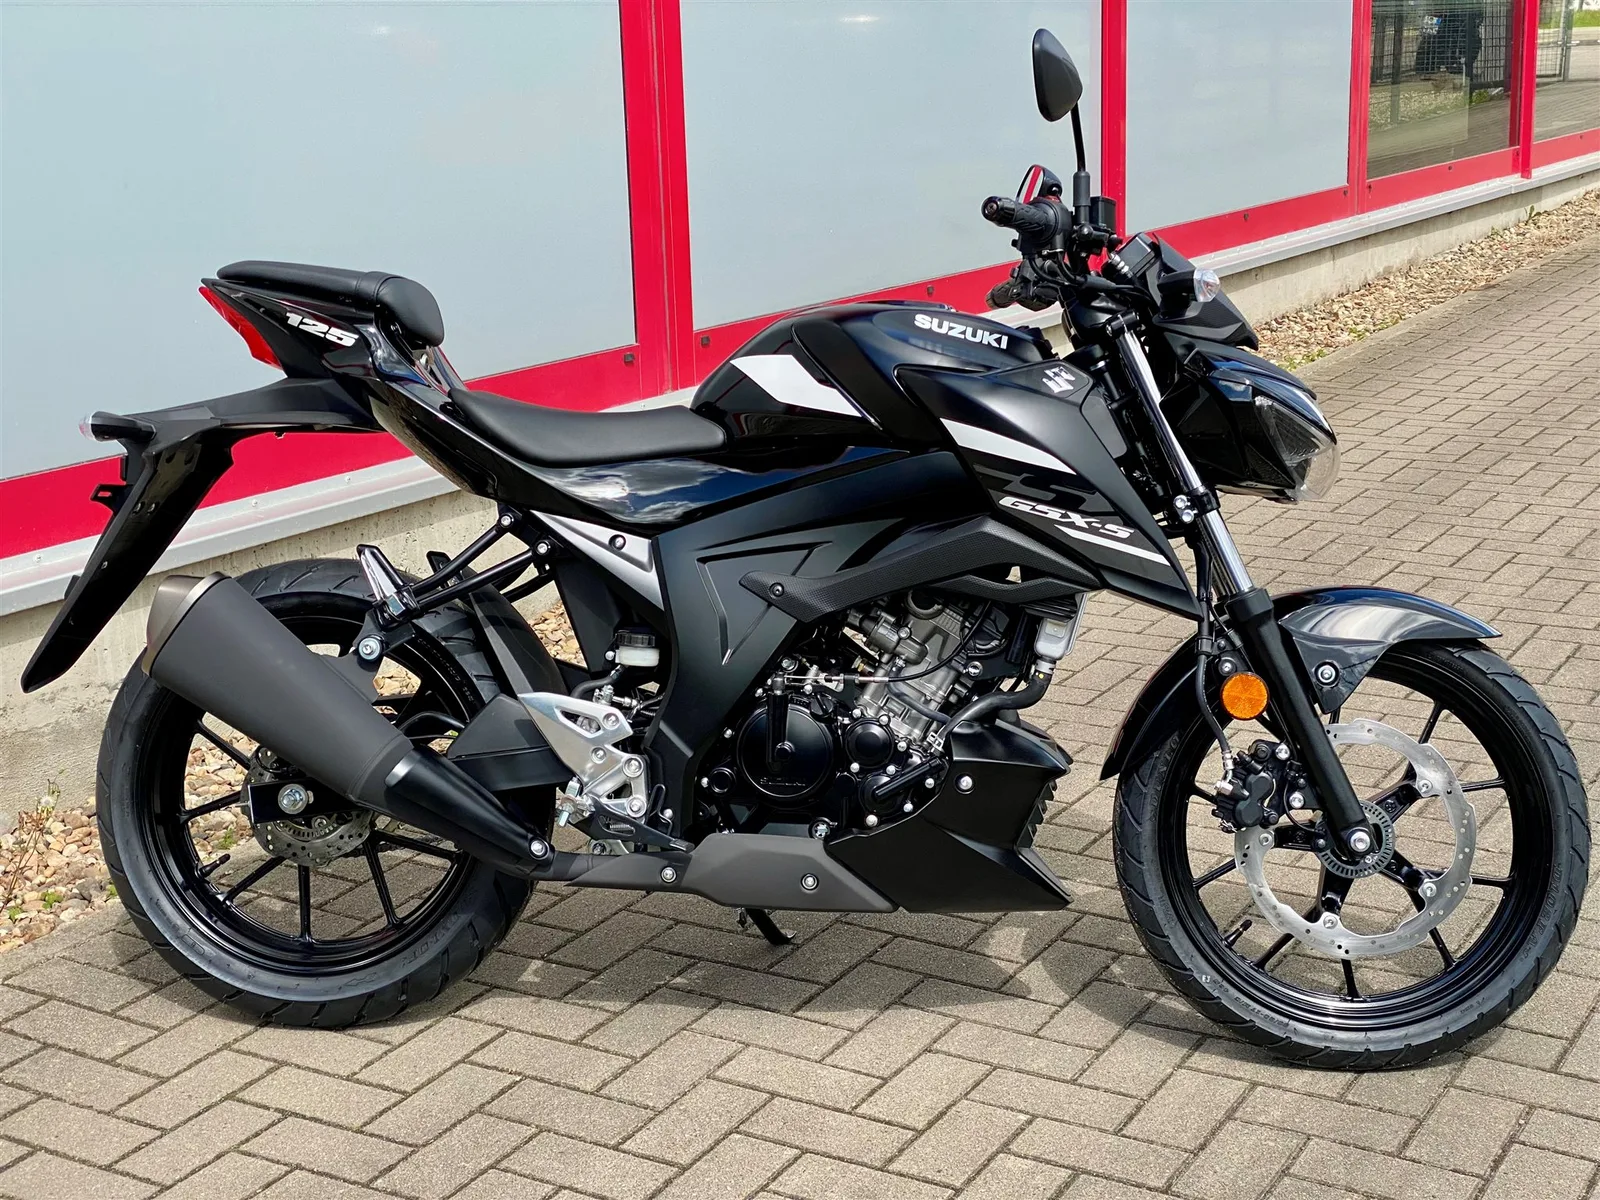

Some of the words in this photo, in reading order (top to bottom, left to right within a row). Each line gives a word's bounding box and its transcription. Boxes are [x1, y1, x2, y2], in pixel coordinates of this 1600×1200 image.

[285, 312, 359, 347] 125
[914, 313, 1008, 350] SUZUKI
[998, 496, 1135, 539] GSX-S
[1150, 732, 1180, 807] DUNLO
